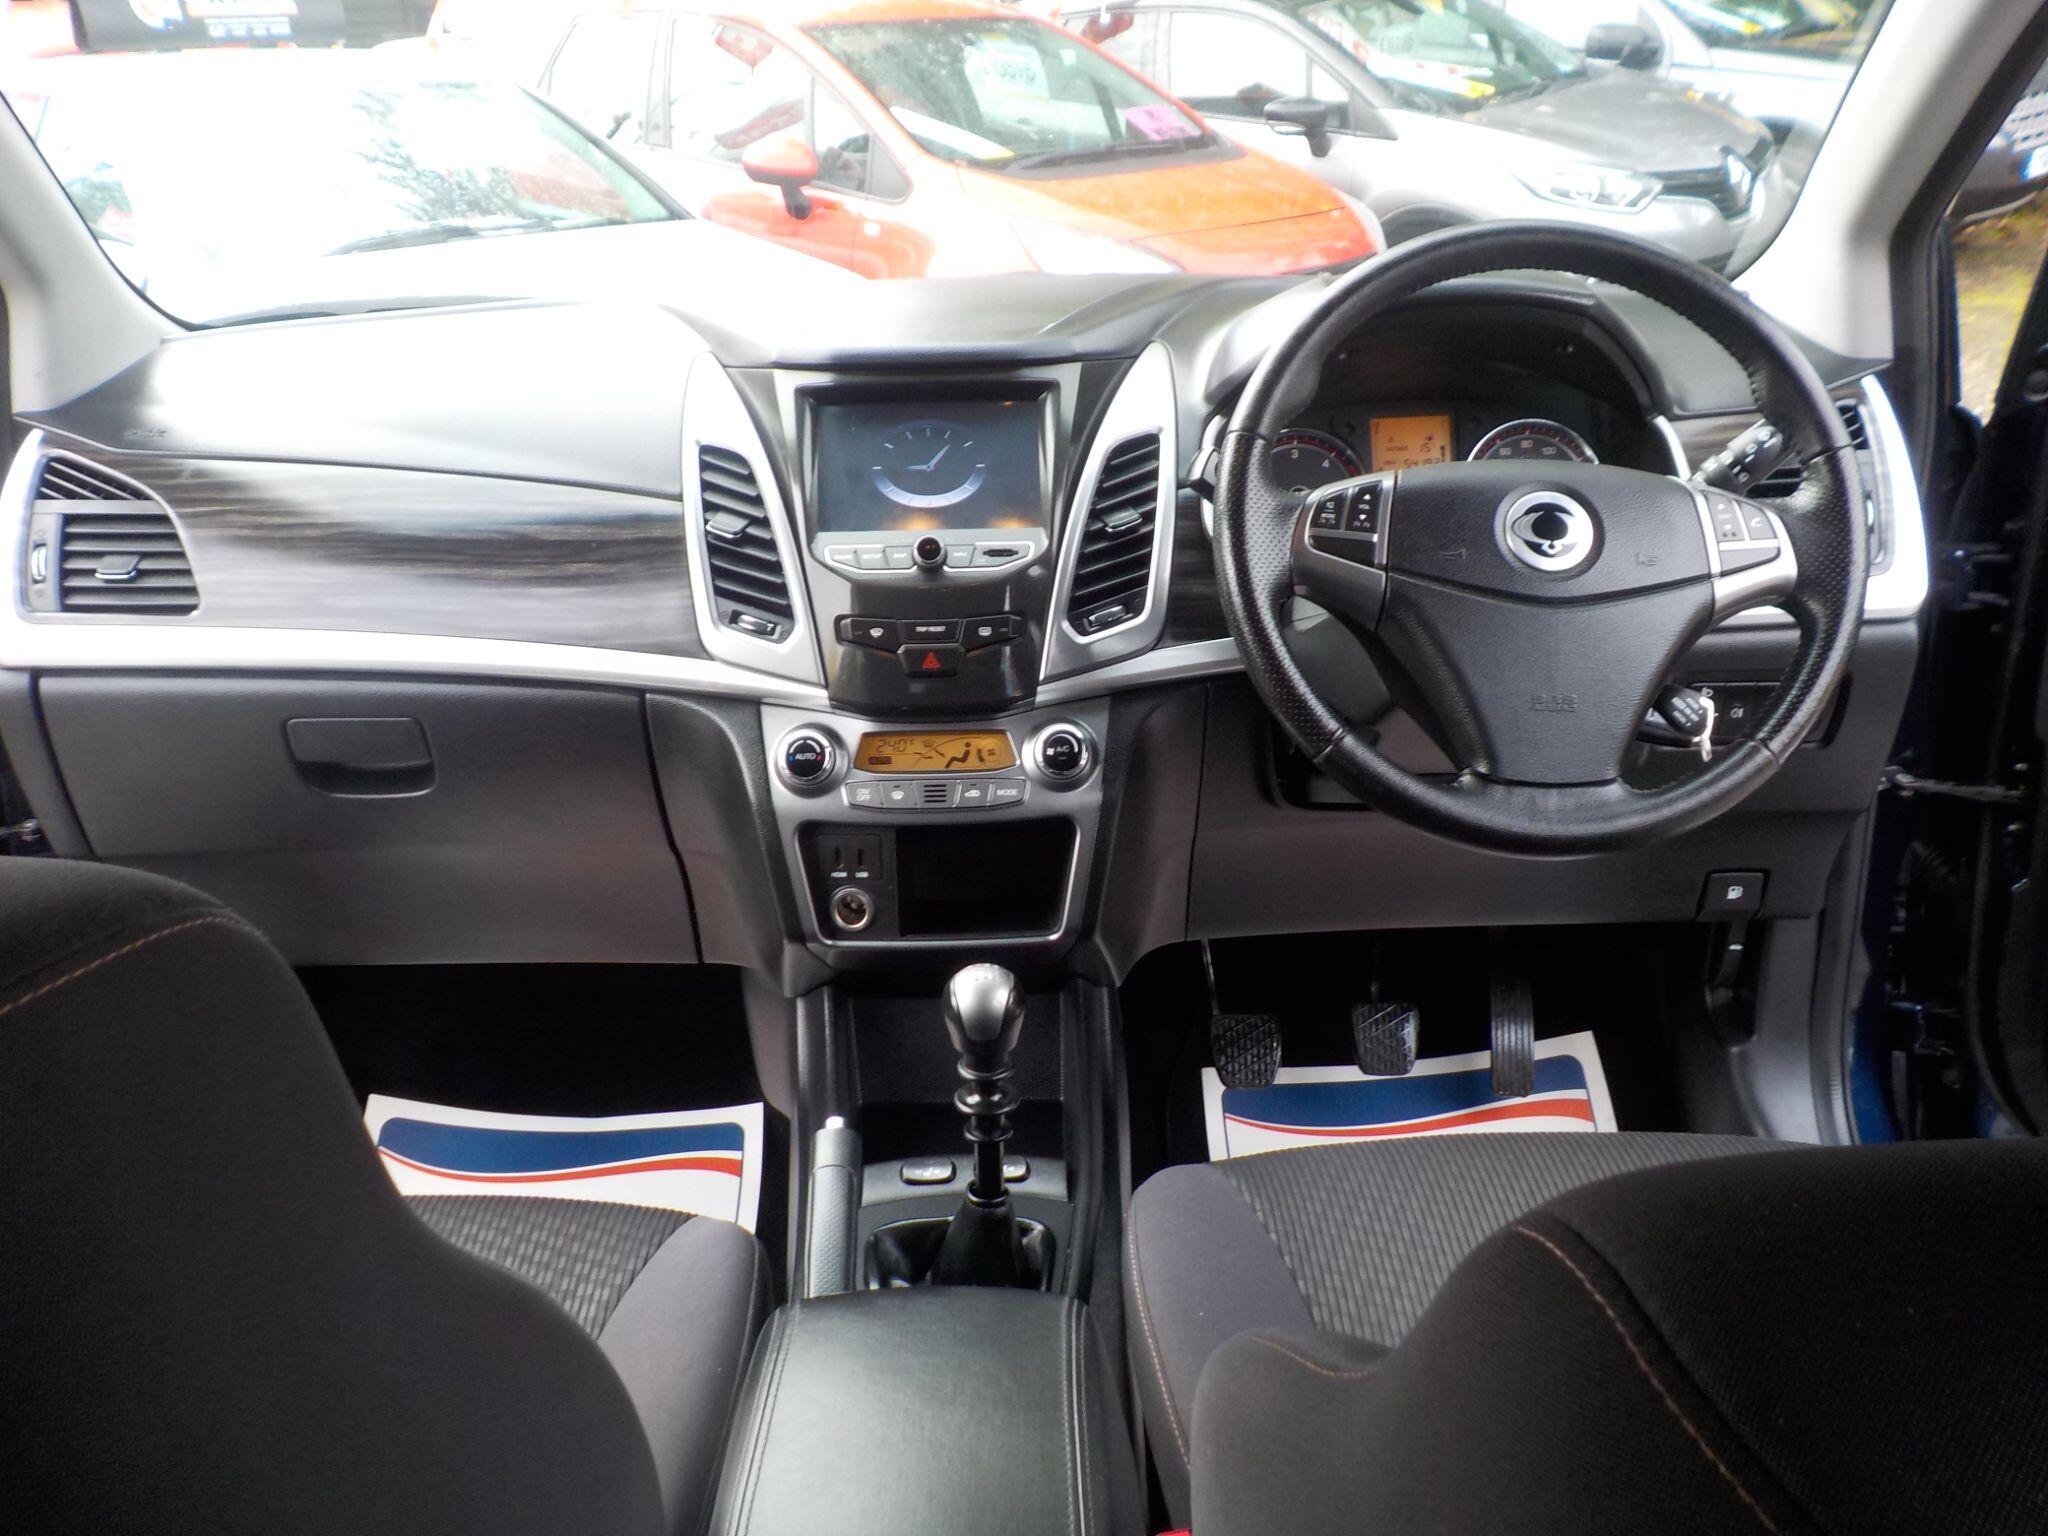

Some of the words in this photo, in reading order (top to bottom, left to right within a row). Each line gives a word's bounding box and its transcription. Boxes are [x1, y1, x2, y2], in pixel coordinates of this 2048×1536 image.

[1520, 440, 1533, 448] 80
[1291, 449, 1299, 459] 3
[1321, 459, 1330, 468] 4
[795, 752, 816, 760] AUTO
[996, 788, 1019, 796] MODE
